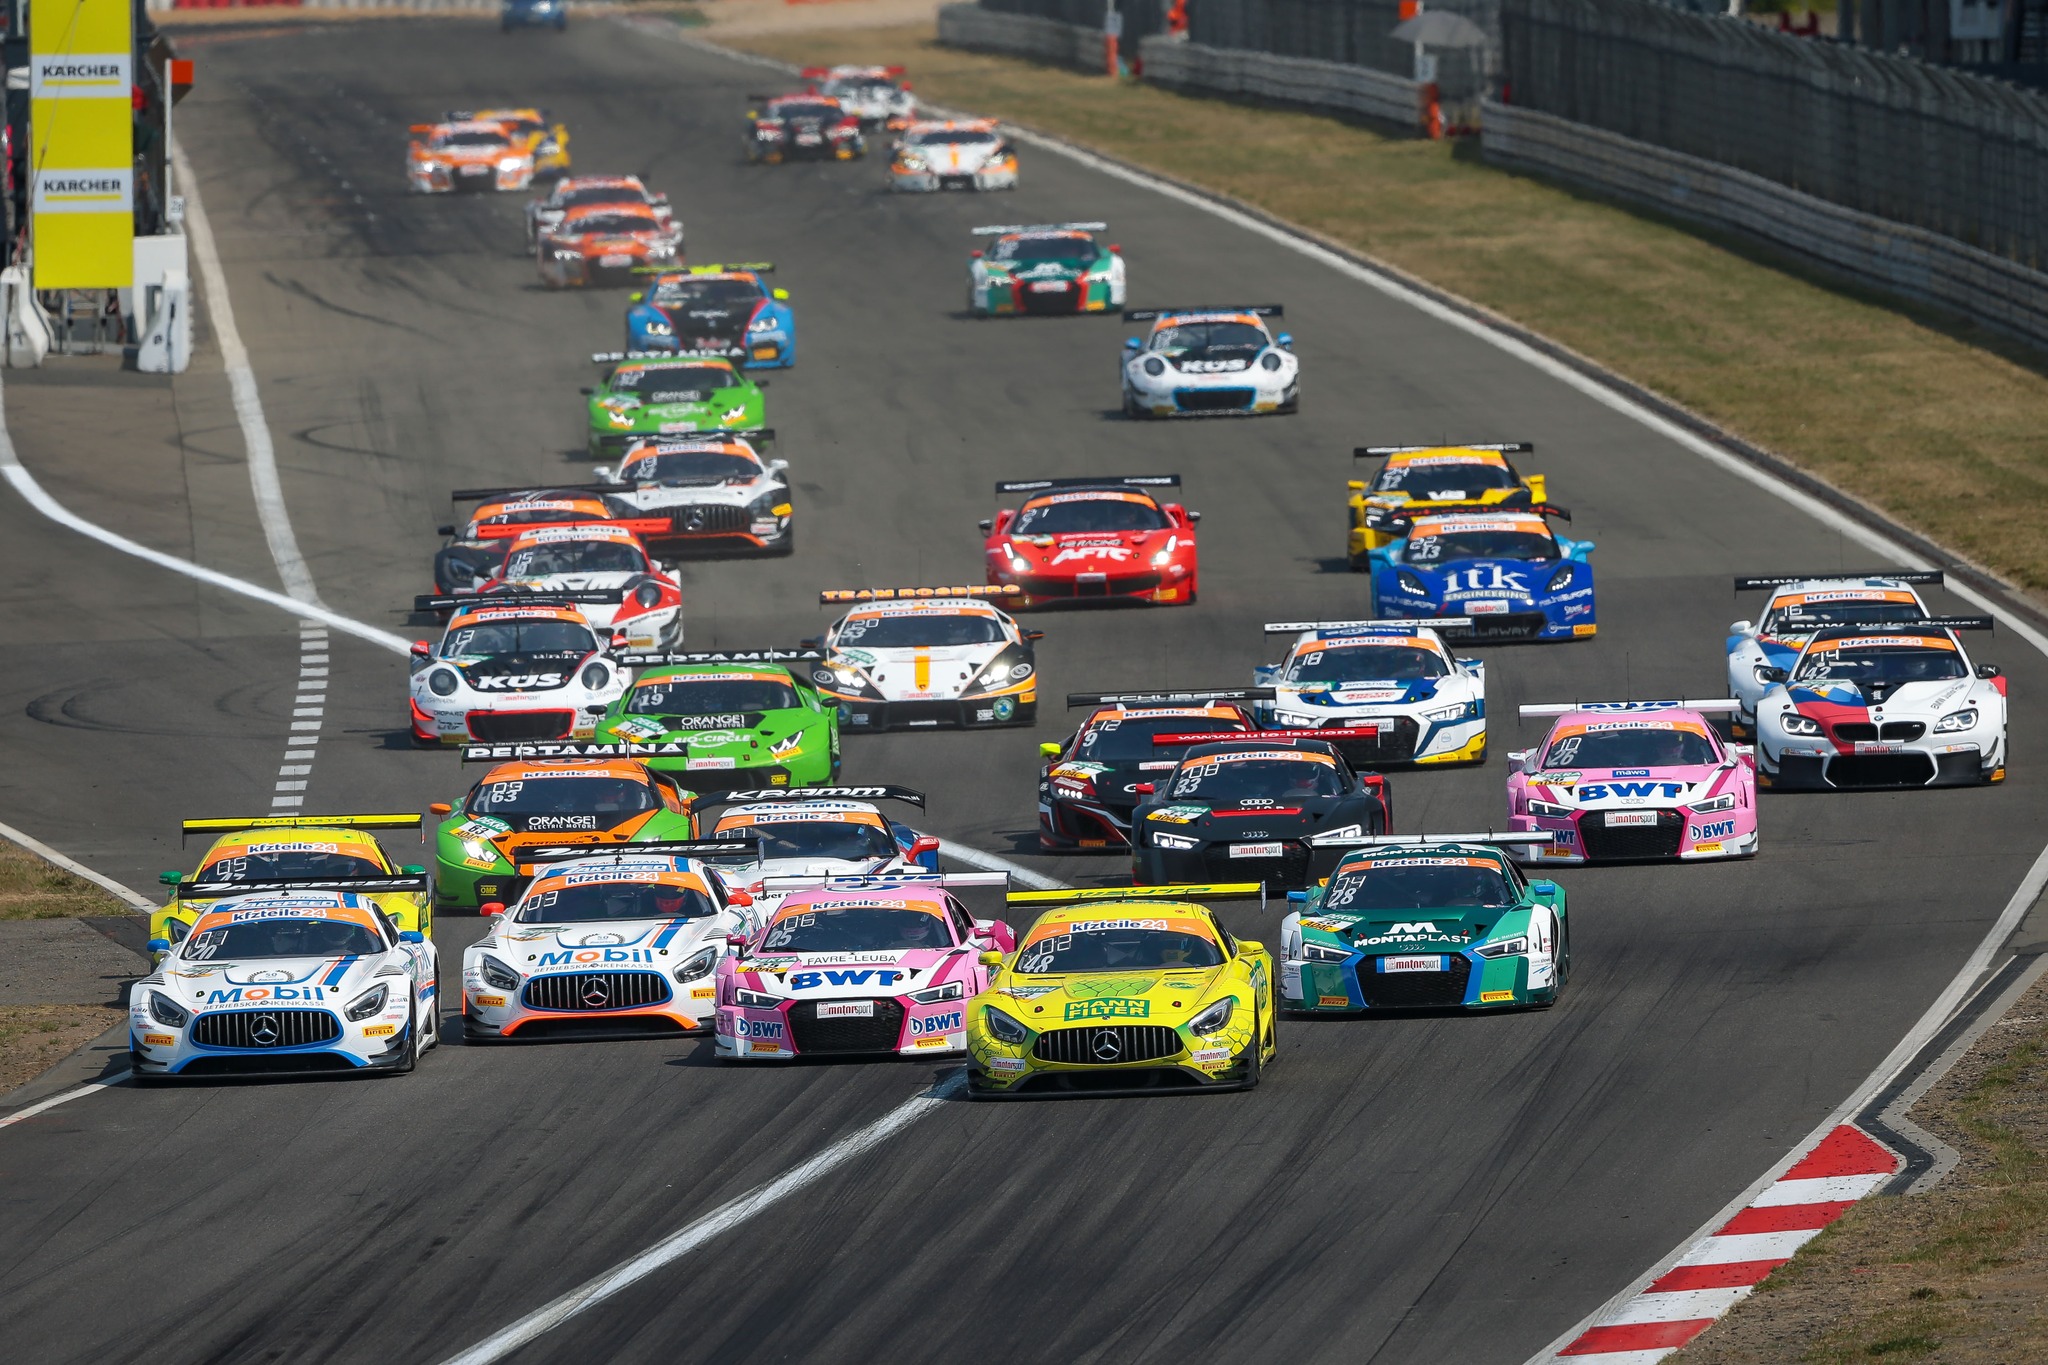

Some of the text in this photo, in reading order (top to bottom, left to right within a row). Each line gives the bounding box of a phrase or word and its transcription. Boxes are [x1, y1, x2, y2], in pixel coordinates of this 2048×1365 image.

[822, 584, 1020, 600] TEAM ROSBERG
[1444, 591, 1528, 600] ENGINEERING
[1840, 637, 1920, 648] kfzteile24
[622, 650, 822, 664] PERTAMINA
[1302, 651, 1324, 666] 18
[1804, 666, 1832, 680] 42
[640, 693, 664, 706] 19
[682, 714, 744, 726] ORANGE1
[1588, 722, 1672, 732] kfzteile24
[674, 734, 750, 744] BIO-CIRCLE
[1083, 732, 1098, 747] 9
[1561, 738, 1582, 750] 10
[468, 743, 684, 758] PERTAMINA
[1216, 751, 1302, 762] kfzteile24
[1550, 750, 1578, 766] 26
[524, 770, 608, 778] kfzteile24
[1174, 778, 1202, 794] 33
[1580, 782, 1682, 802] BWT
[491, 792, 517, 802] 63
[476, 816, 509, 832] DEKRA
[528, 816, 596, 826] ORANGE1
[756, 814, 843, 823] kfzteile24
[1616, 814, 1656, 824] motorsport
[468, 824, 490, 834] 63
[1704, 820, 1734, 838] BWT
[456, 830, 480, 842] ADAC
[248, 843, 336, 853] kfzteile24
[534, 844, 746, 856] ZAKSPEED
[1240, 844, 1281, 855] motorsport
[1362, 848, 1478, 858] MONTAPLAST
[216, 856, 247, 876] 05
[466, 858, 493, 869] PIRELLI
[1372, 858, 1467, 868] kfzteile24
[568, 872, 658, 884] kfzteile24
[1332, 876, 1366, 892] 04
[192, 878, 420, 892] ZAKSPEED
[480, 886, 497, 894] OMP
[527, 890, 558, 910] 03
[1327, 888, 1356, 908] 28
[812, 900, 905, 910] kfzteile24
[234, 909, 324, 921] kfzteile24
[784, 913, 816, 932] 06
[1072, 920, 1166, 932] kfzteile24
[1305, 922, 1332, 932] ADAC
[766, 930, 797, 948] 25
[1354, 934, 1472, 948] MONTAPLAST
[1040, 935, 1072, 956] 02
[538, 949, 653, 966] Mobil
[808, 954, 896, 965] FAVRE-LEUBA
[1023, 954, 1054, 972] 48
[534, 963, 654, 973] BETRIEBSKRANKENKASSE
[1396, 959, 1439, 970] motorsport
[792, 970, 901, 990] BWT
[206, 986, 324, 1004] Mobil
[693, 990, 716, 998] PIREL
[1483, 992, 1512, 1001] PIRELLI
[203, 1001, 326, 1010] BETRIEBSKRANKENKASSE
[477, 996, 503, 1006] PIRELLI
[1069, 1000, 1146, 1010] MANN
[1321, 998, 1347, 1006] PIRELLI
[828, 1004, 872, 1016] motorsport
[1068, 1006, 1145, 1019] FILTER
[926, 1012, 962, 1032] BWT
[365, 1026, 394, 1036] PIRELLI
[752, 1022, 783, 1038] BWT
[145, 1036, 171, 1045] PIRELLI
[917, 1038, 944, 1047] PIRELLI
[753, 1044, 778, 1052] PIRELLI
[1200, 1050, 1230, 1061] motorsport
[996, 1060, 1025, 1070] motorsport
[1202, 1062, 1226, 1070] PIRELLI
